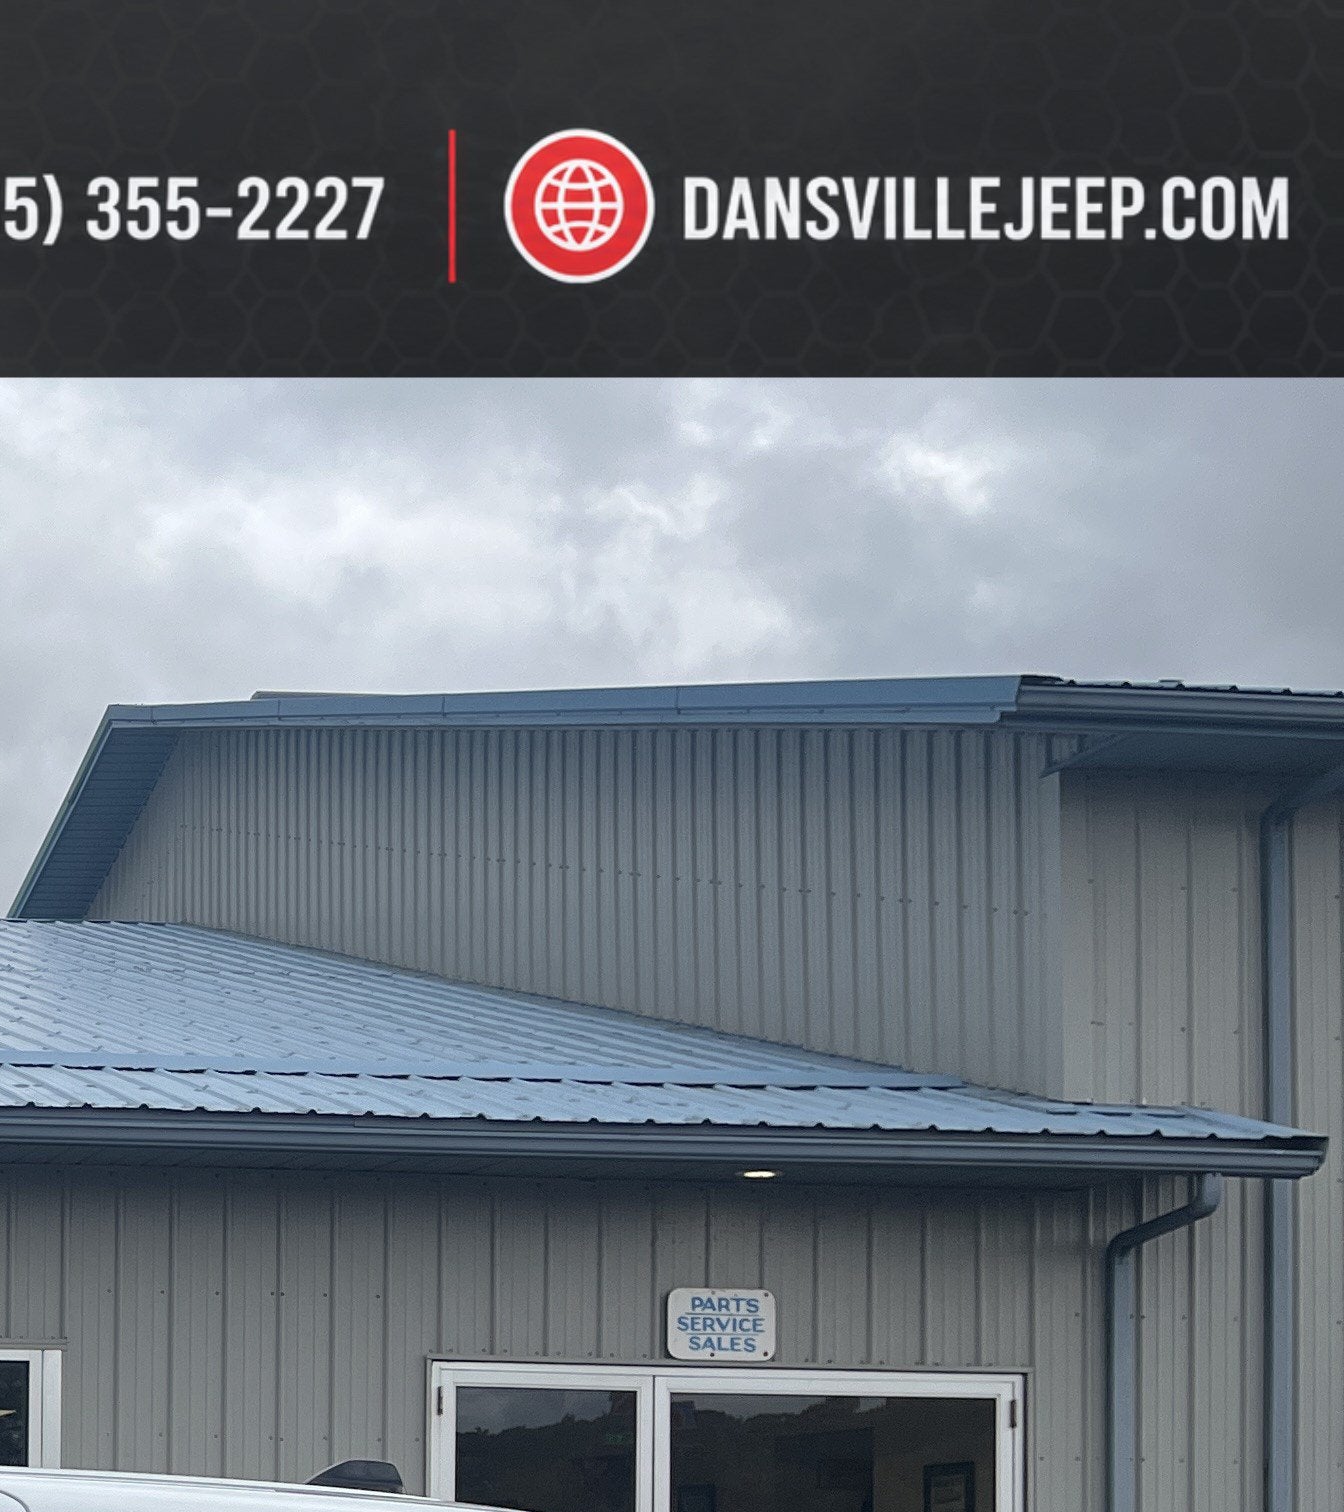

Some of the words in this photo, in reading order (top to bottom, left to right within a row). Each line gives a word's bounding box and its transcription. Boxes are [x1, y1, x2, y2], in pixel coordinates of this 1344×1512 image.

[691, 1296, 760, 1313] PARTS
[677, 1316, 765, 1333] SERVICE
[688, 1336, 757, 1353] SALES
